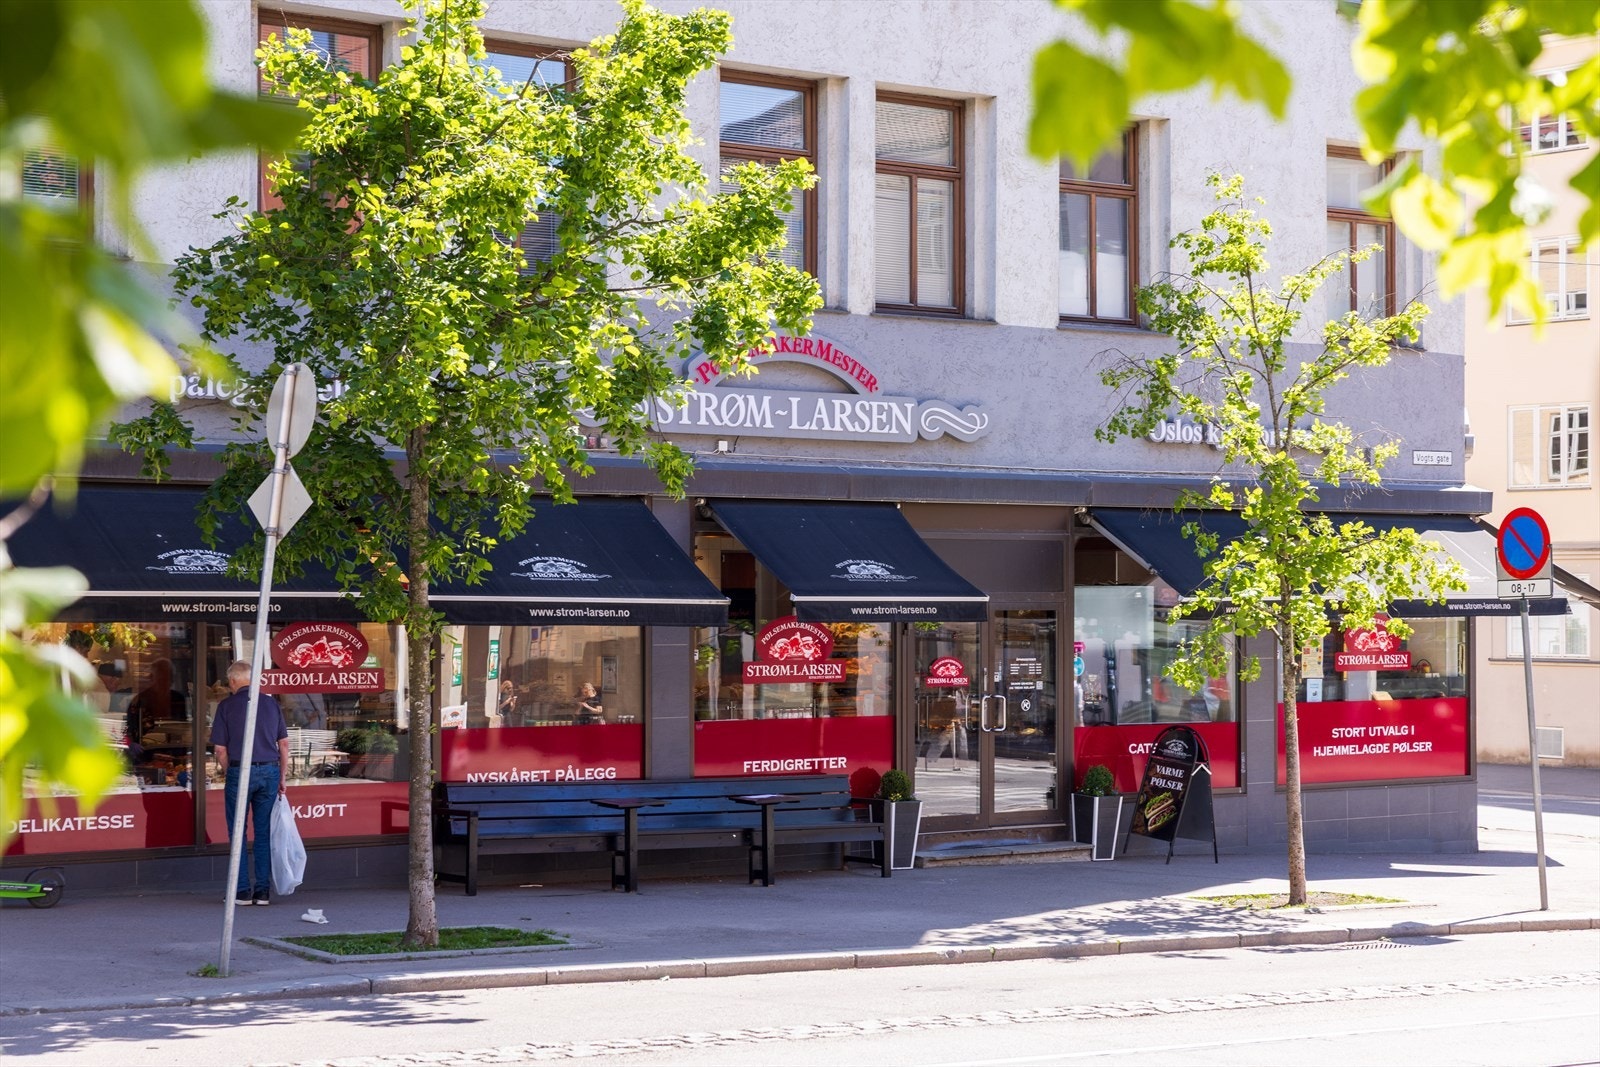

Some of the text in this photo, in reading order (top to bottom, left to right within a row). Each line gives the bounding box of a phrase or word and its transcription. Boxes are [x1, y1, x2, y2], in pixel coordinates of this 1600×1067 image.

[1150, 418, 1203, 443] Oslos
[1416, 453, 1450, 464] Vogts gate
[529, 607, 631, 618] www.strom-larsen.no
[851, 606, 938, 615] www.strom-larsen.no
[1448, 602, 1511, 610] www.strom-larsen.no
[277, 624, 363, 651] PØLSEMAKERMESTER
[760, 621, 830, 645] PØLSEMAKERMESTER
[1337, 654, 1408, 666] STRØM-LARSEN
[746, 663, 842, 677] STRØM-LARSEN
[260, 671, 379, 686] STRØM-LARSEN
[1331, 725, 1415, 739] STORT UTVALG I
[1313, 741, 1432, 757] HJEMMELAGDE PØLSER
[743, 756, 847, 773] FERDIGRETTER
[1156, 764, 1185, 779] VARME
[467, 764, 617, 784] NYSKÅRET PÅLEGG
[1150, 776, 1183, 791] PØLSER
[6, 814, 135, 834] DELIKATESSE
